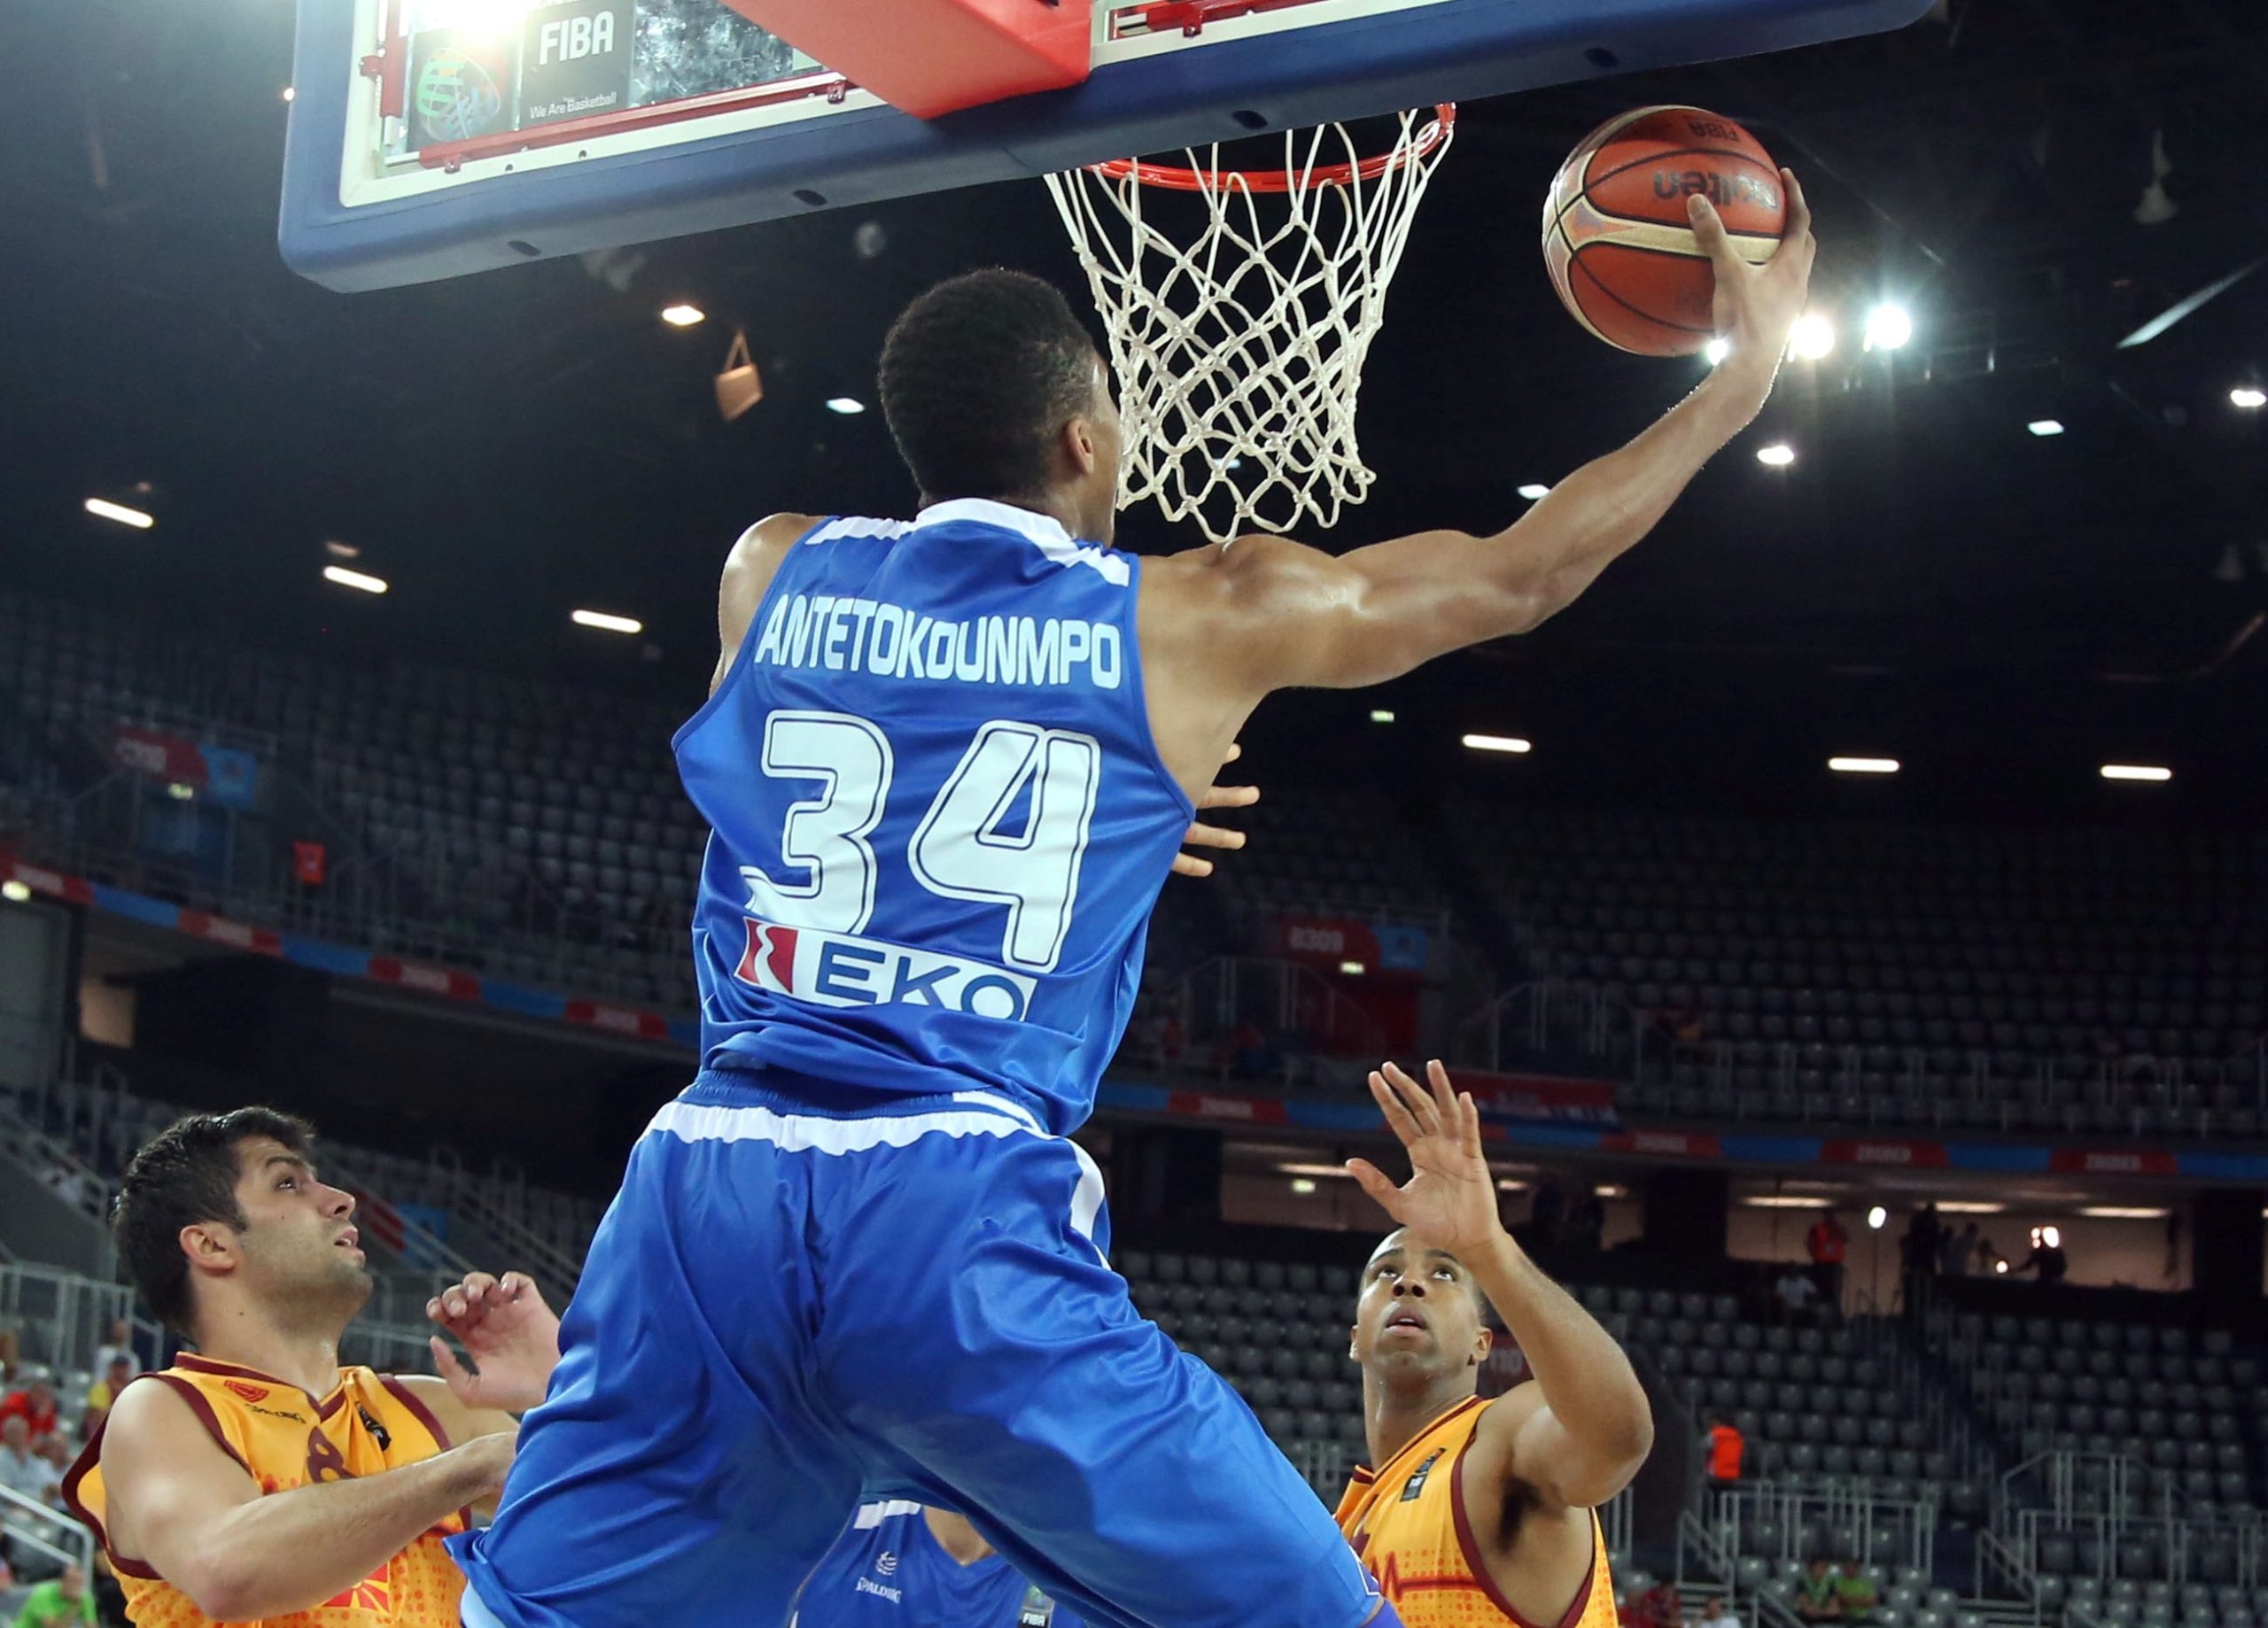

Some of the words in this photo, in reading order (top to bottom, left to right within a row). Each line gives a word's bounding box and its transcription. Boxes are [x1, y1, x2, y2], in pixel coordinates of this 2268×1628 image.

[539, 11, 615, 66] FIBA
[529, 105, 547, 120] We
[548, 102, 566, 116] Are
[567, 91, 617, 112] Basketball
[754, 593, 1122, 690] ANTETOKOUNMPO
[739, 709, 1101, 973] 34
[814, 944, 1026, 1023] EKO
[854, 1577, 903, 1605] SPALDING
[1022, 1612, 1046, 1627] FIBA
